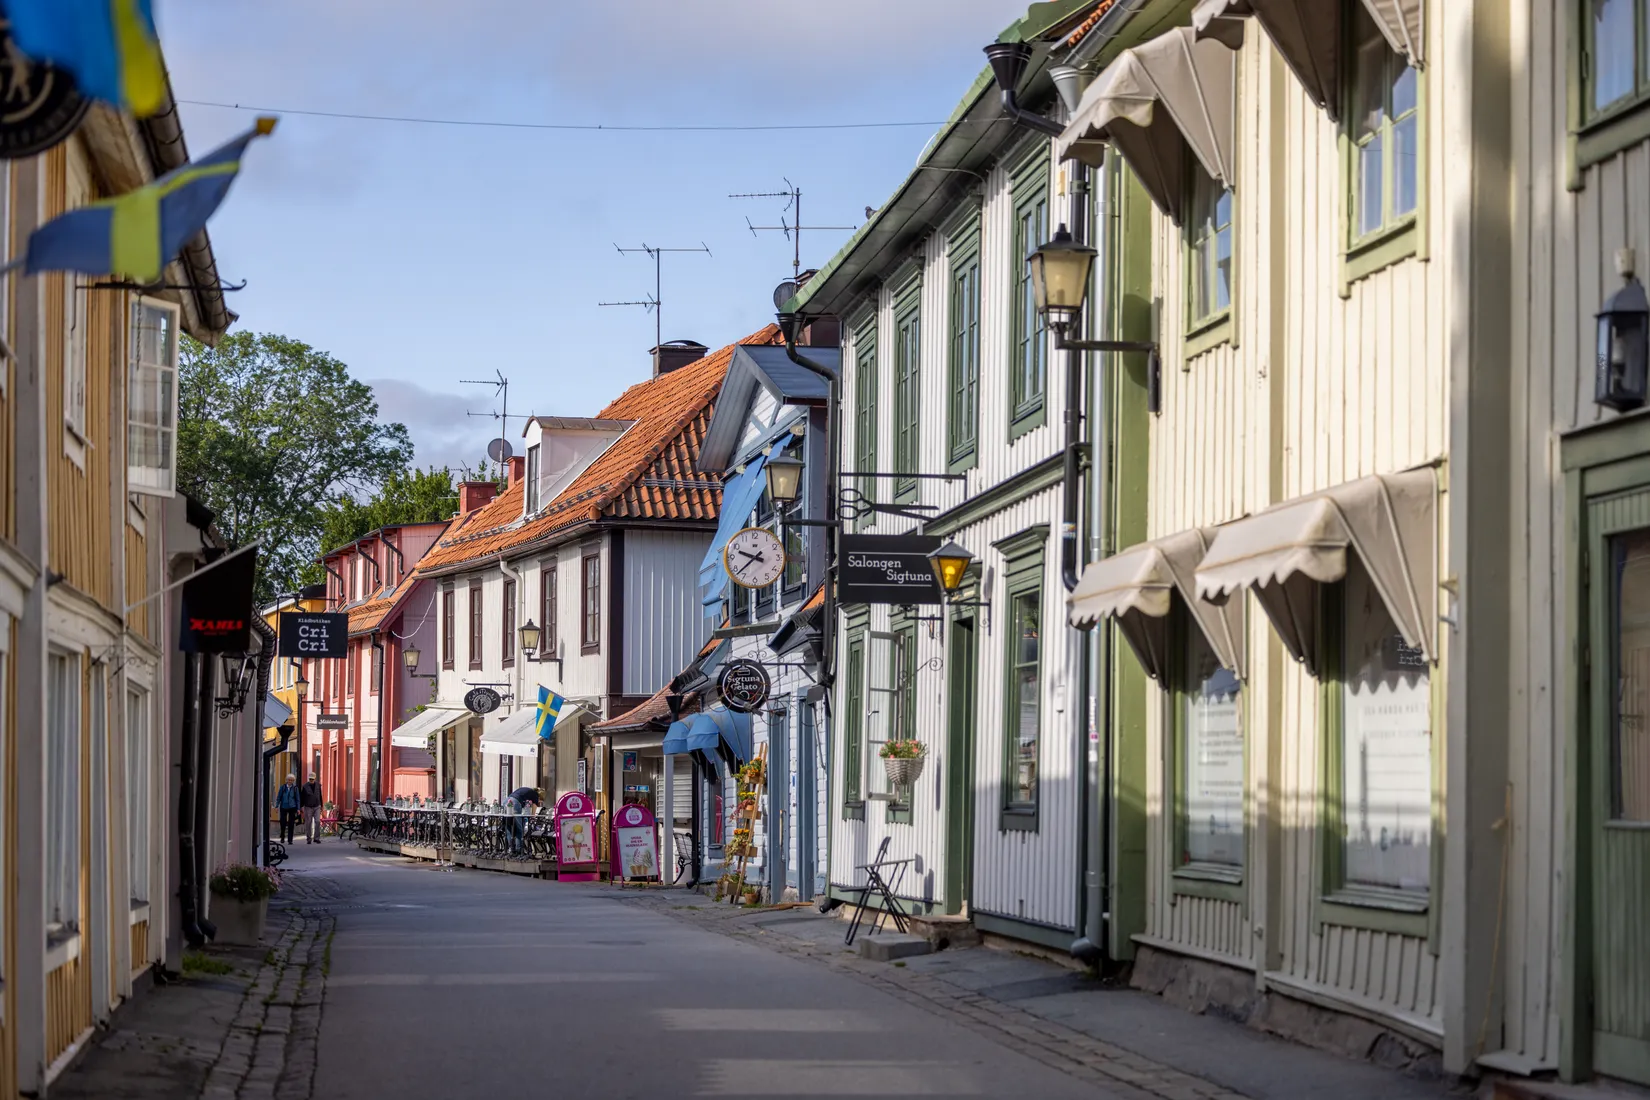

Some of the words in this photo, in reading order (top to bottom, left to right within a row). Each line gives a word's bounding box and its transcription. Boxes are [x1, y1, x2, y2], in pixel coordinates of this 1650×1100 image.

[751, 532, 758, 540] 12
[734, 543, 740, 551] 10
[771, 543, 778, 551] 2
[848, 555, 902, 571] Salongen
[886, 569, 932, 584] Sigtuna
[299, 625, 329, 637] Cri
[298, 639, 329, 651] Cri
[727, 676, 760, 686] Sigtuna
